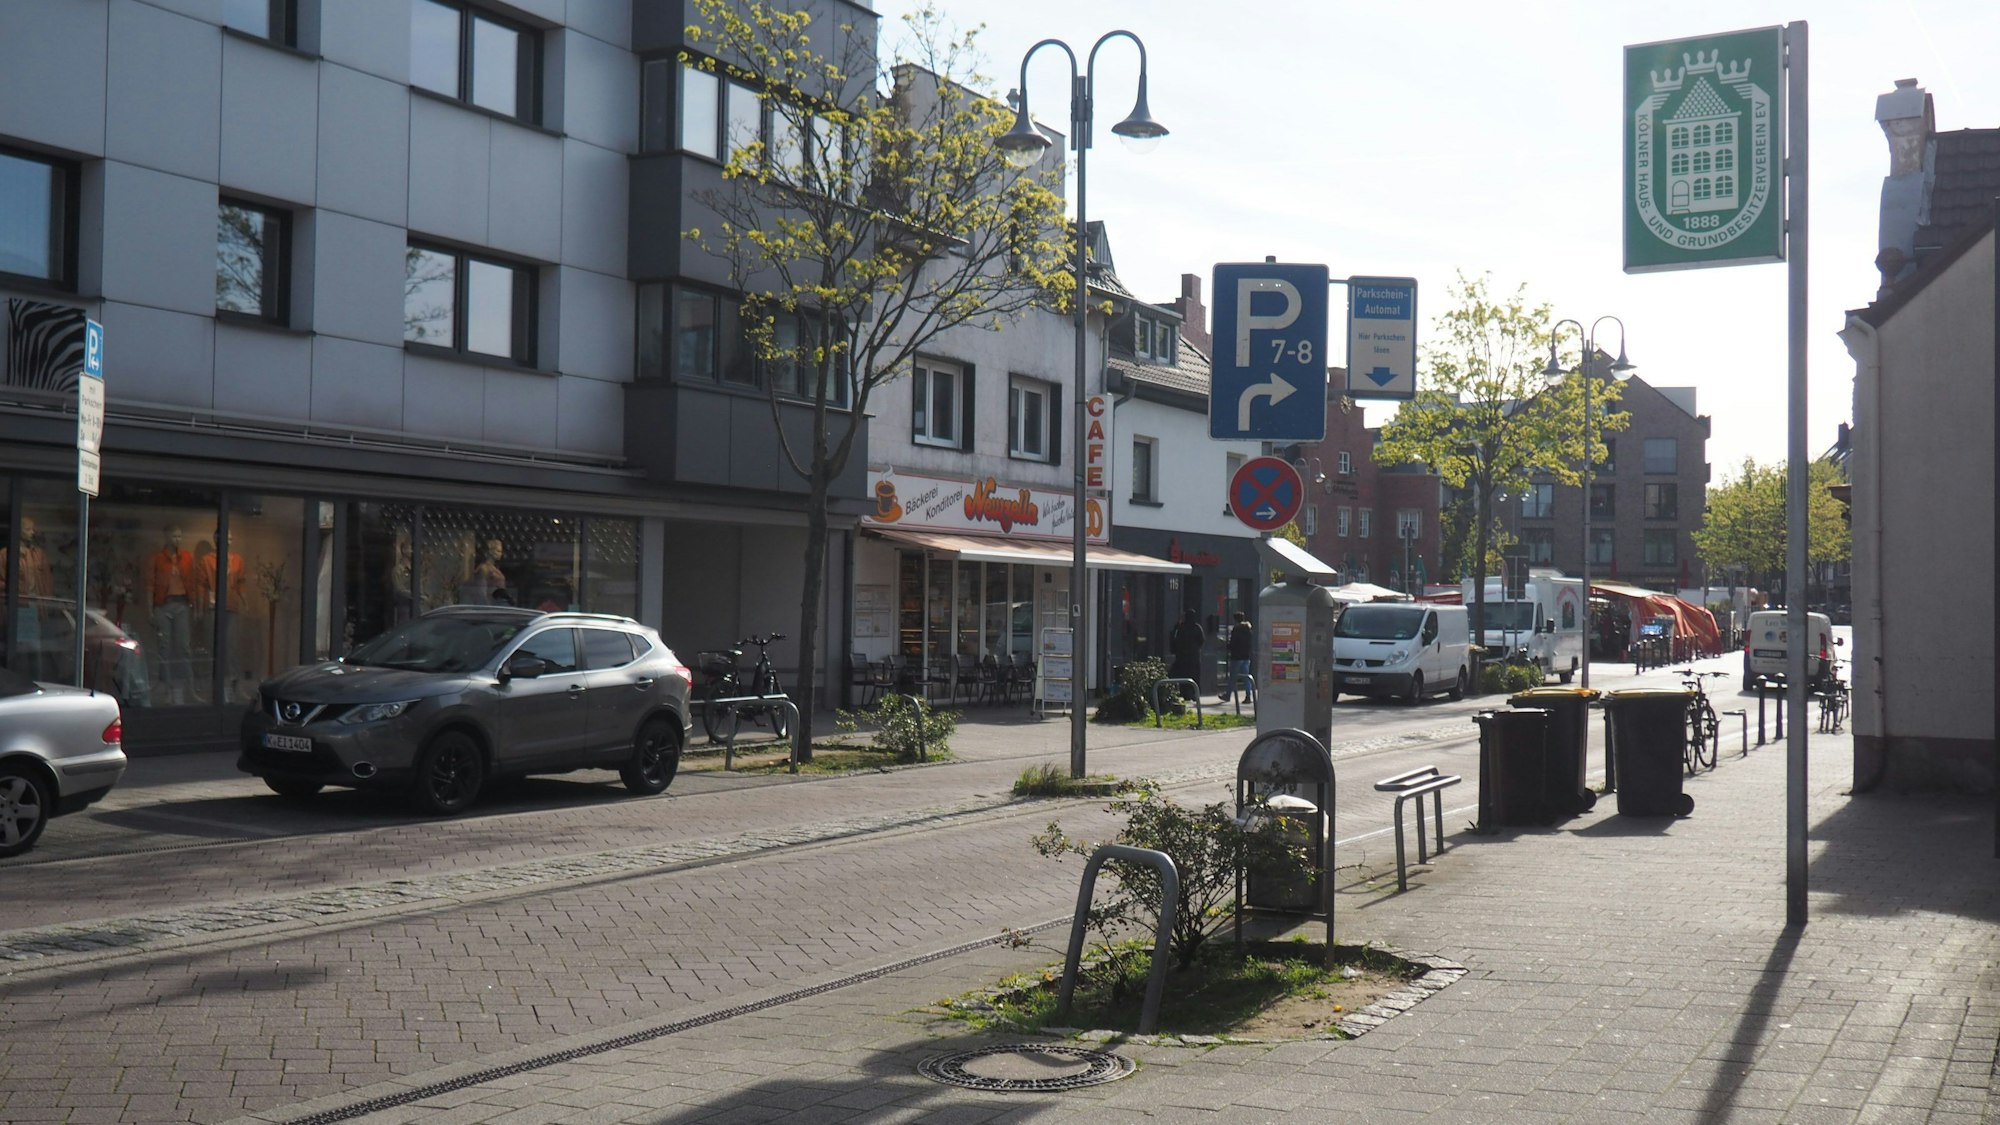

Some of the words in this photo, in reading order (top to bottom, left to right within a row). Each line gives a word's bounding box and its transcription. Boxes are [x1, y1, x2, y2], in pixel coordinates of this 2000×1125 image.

[1638, 114, 1650, 167] KÖLNER
[1638, 174, 1652, 214] HAUS-
[1677, 127, 1766, 247] GRUNDBESITZERVEREIN
[1649, 215, 1674, 240] UND
[1683, 215, 1720, 229] 1888
[1356, 287, 1409, 301] Parkschein-
[1364, 303, 1401, 316] Automat
[1235, 278, 1303, 368] P
[1358, 332, 1371, 341] Hier
[1373, 332, 1406, 342] Parkschein
[88, 328, 98, 368] P
[1271, 339, 1313, 365] 7-8
[1087, 397, 1105, 487] CAFE
[905, 483, 938, 515] Bäckerei
[925, 486, 963, 521] Konditorei
